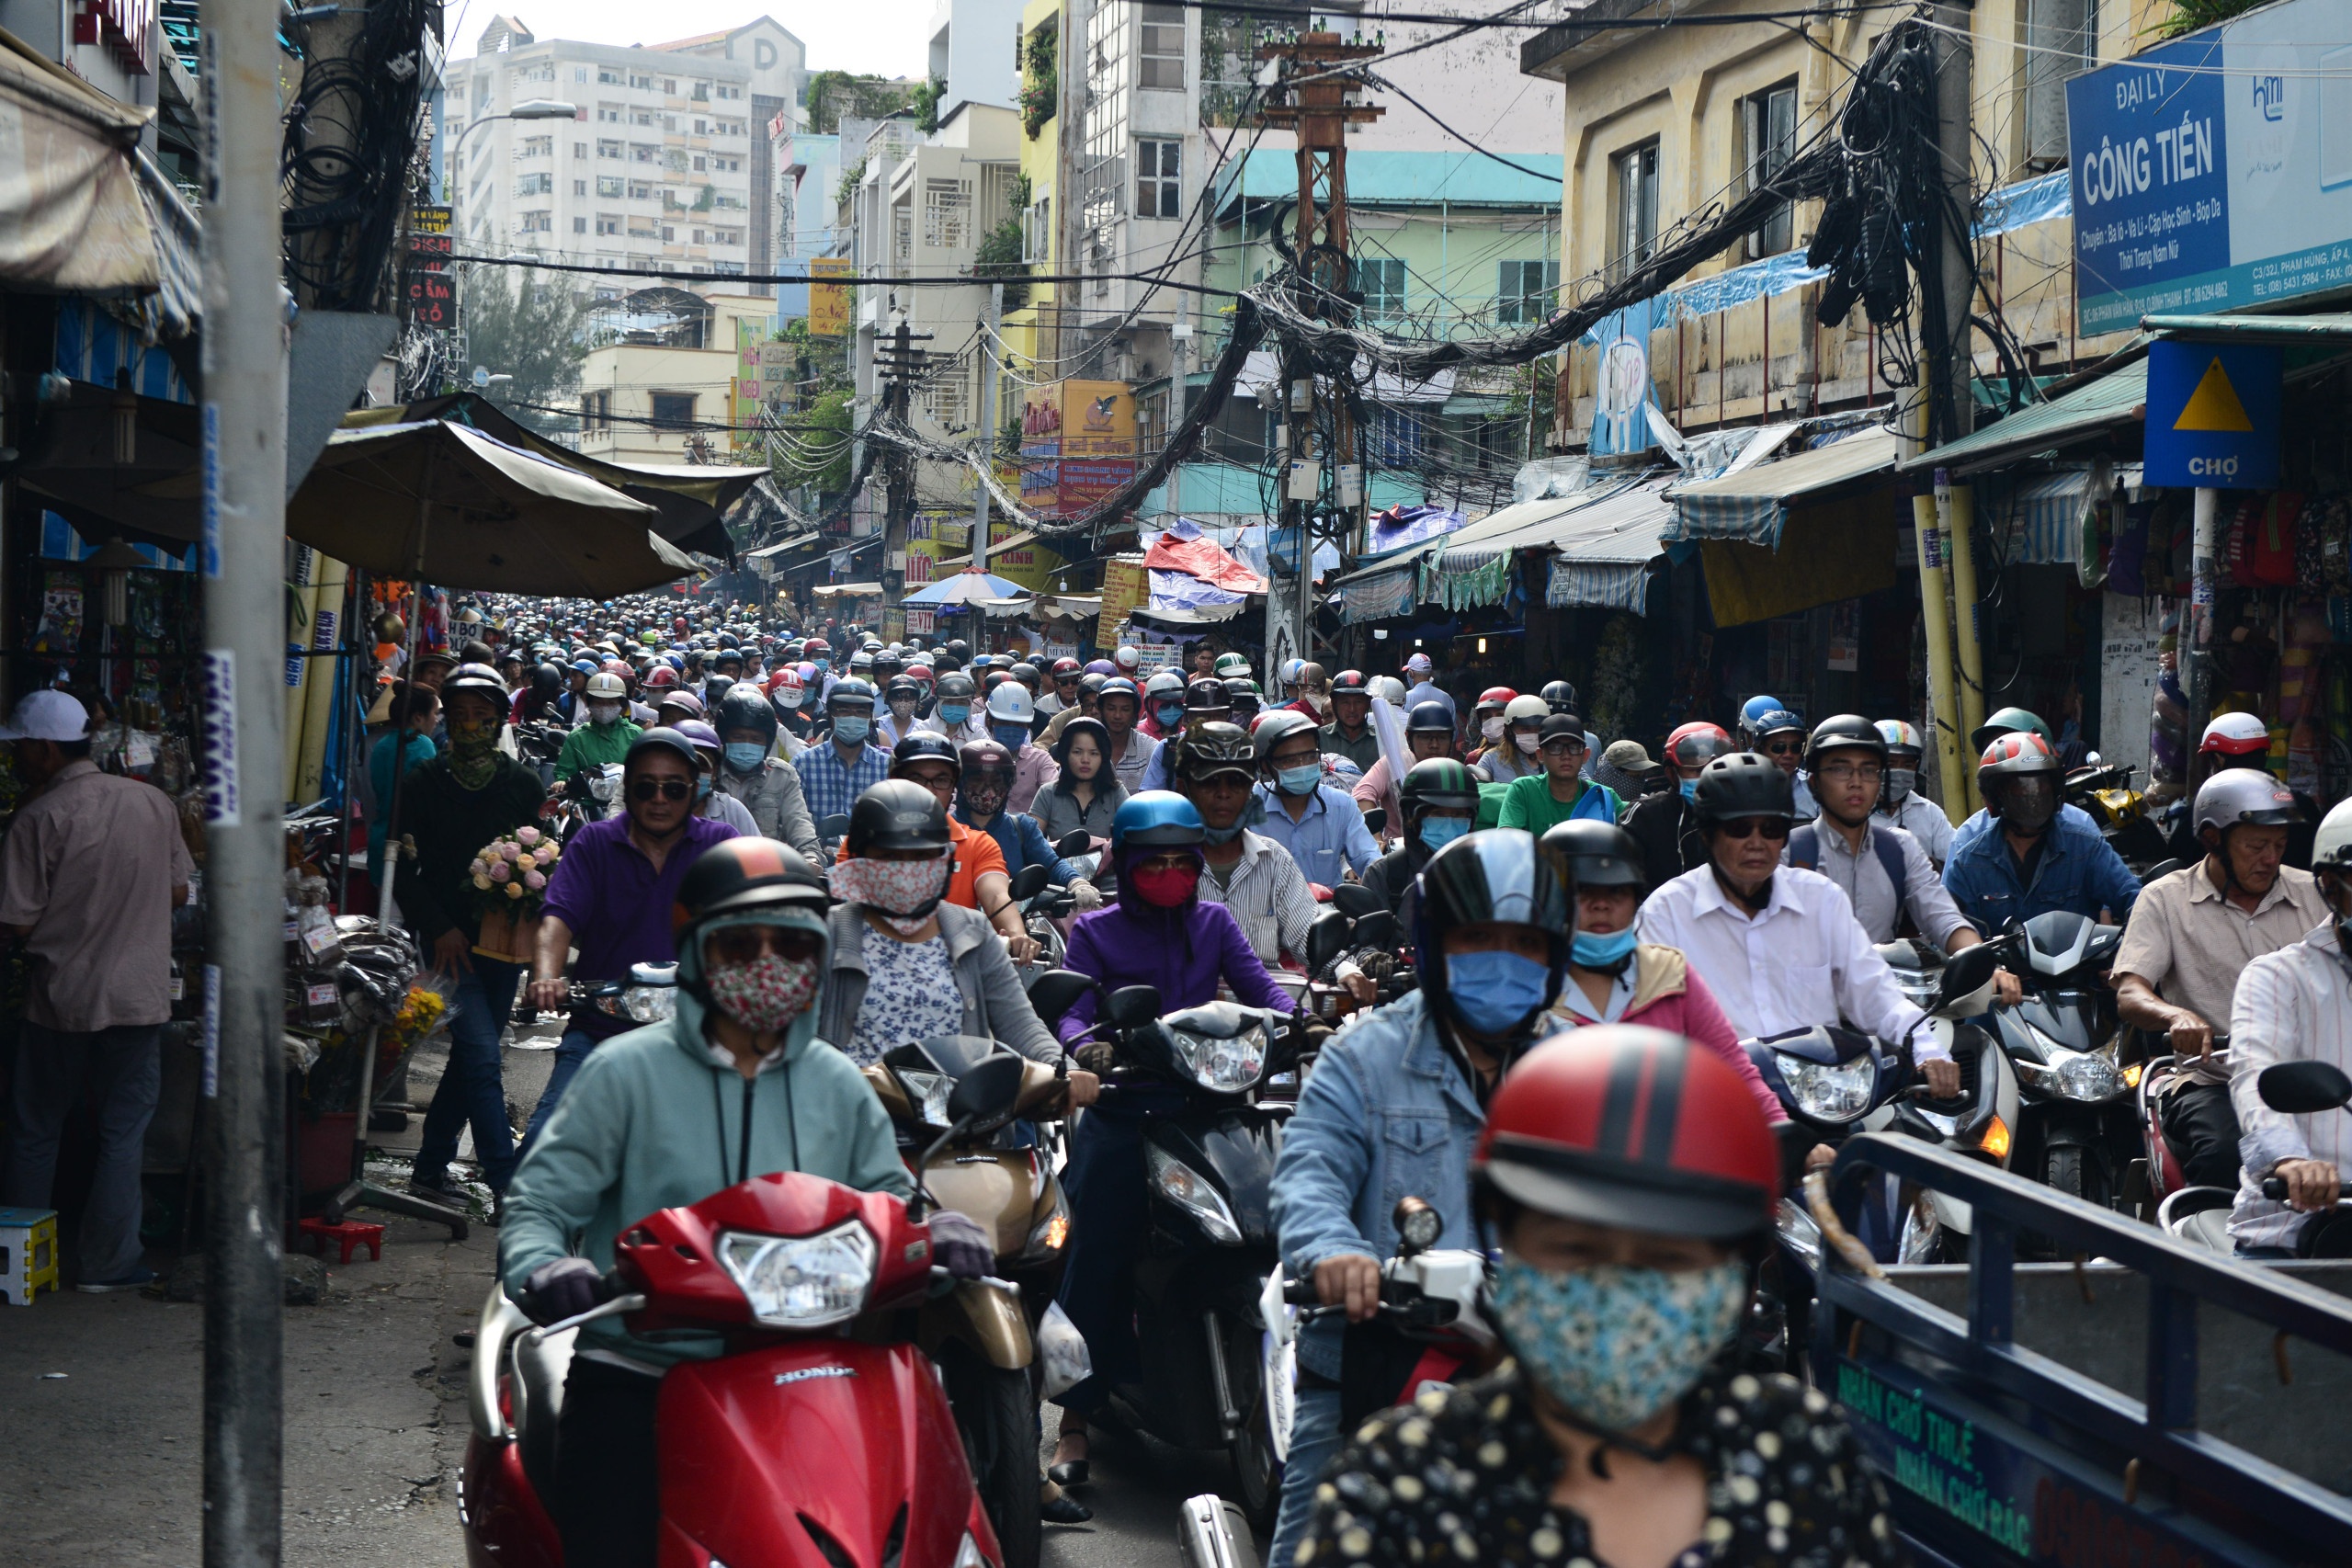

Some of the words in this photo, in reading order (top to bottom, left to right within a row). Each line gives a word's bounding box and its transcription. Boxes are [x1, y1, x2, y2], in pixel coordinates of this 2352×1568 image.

[755, 38, 778, 70] D
[2116, 75, 2142, 113] ĐẠI
[2083, 135, 2151, 206] CÔNG
[2155, 109, 2213, 186] TIẾN
[2176, 204, 2191, 226] Sinh
[2210, 197, 2221, 219] Da
[2134, 246, 2153, 270] Trang
[2153, 244, 2167, 264] Nam
[2280, 258, 2302, 274] PHẠM
[2268, 279, 2282, 294] (08)
[2283, 276, 2300, 290] 5431
[2188, 455, 2239, 483] CHỢ
[917, 611, 933, 633] VỊT
